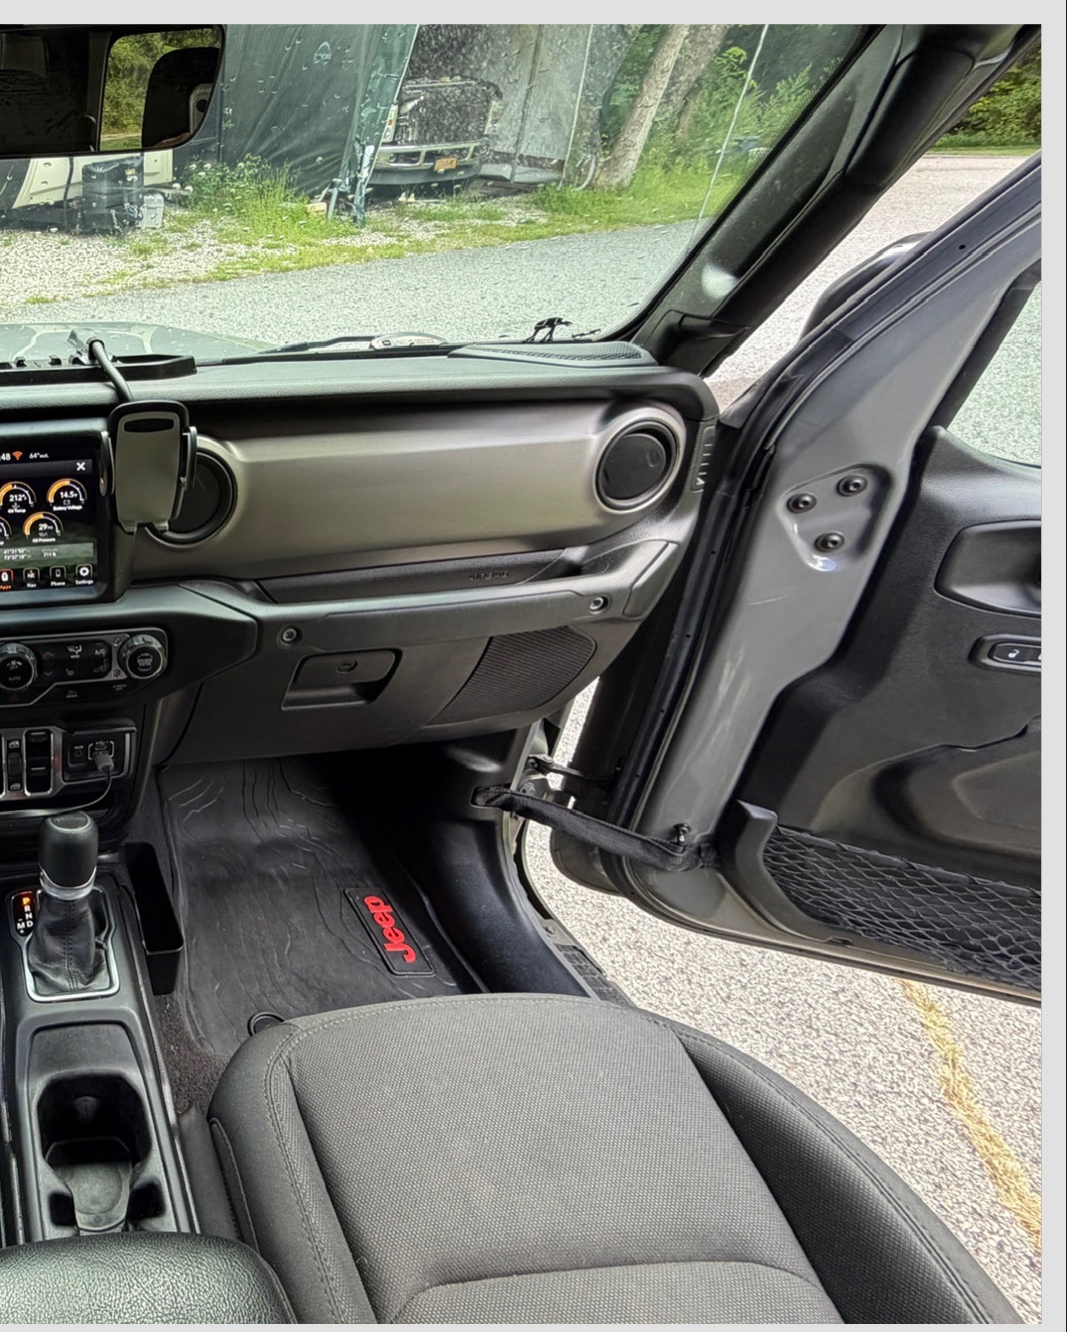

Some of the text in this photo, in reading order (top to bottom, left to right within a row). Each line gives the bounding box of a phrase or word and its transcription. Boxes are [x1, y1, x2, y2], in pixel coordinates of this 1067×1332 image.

[74, 579, 94, 587] Settings
[22, 896, 31, 905] P
[24, 904, 32, 912] R
[16, 920, 34, 929] M D
[363, 895, 417, 964] Jeep
